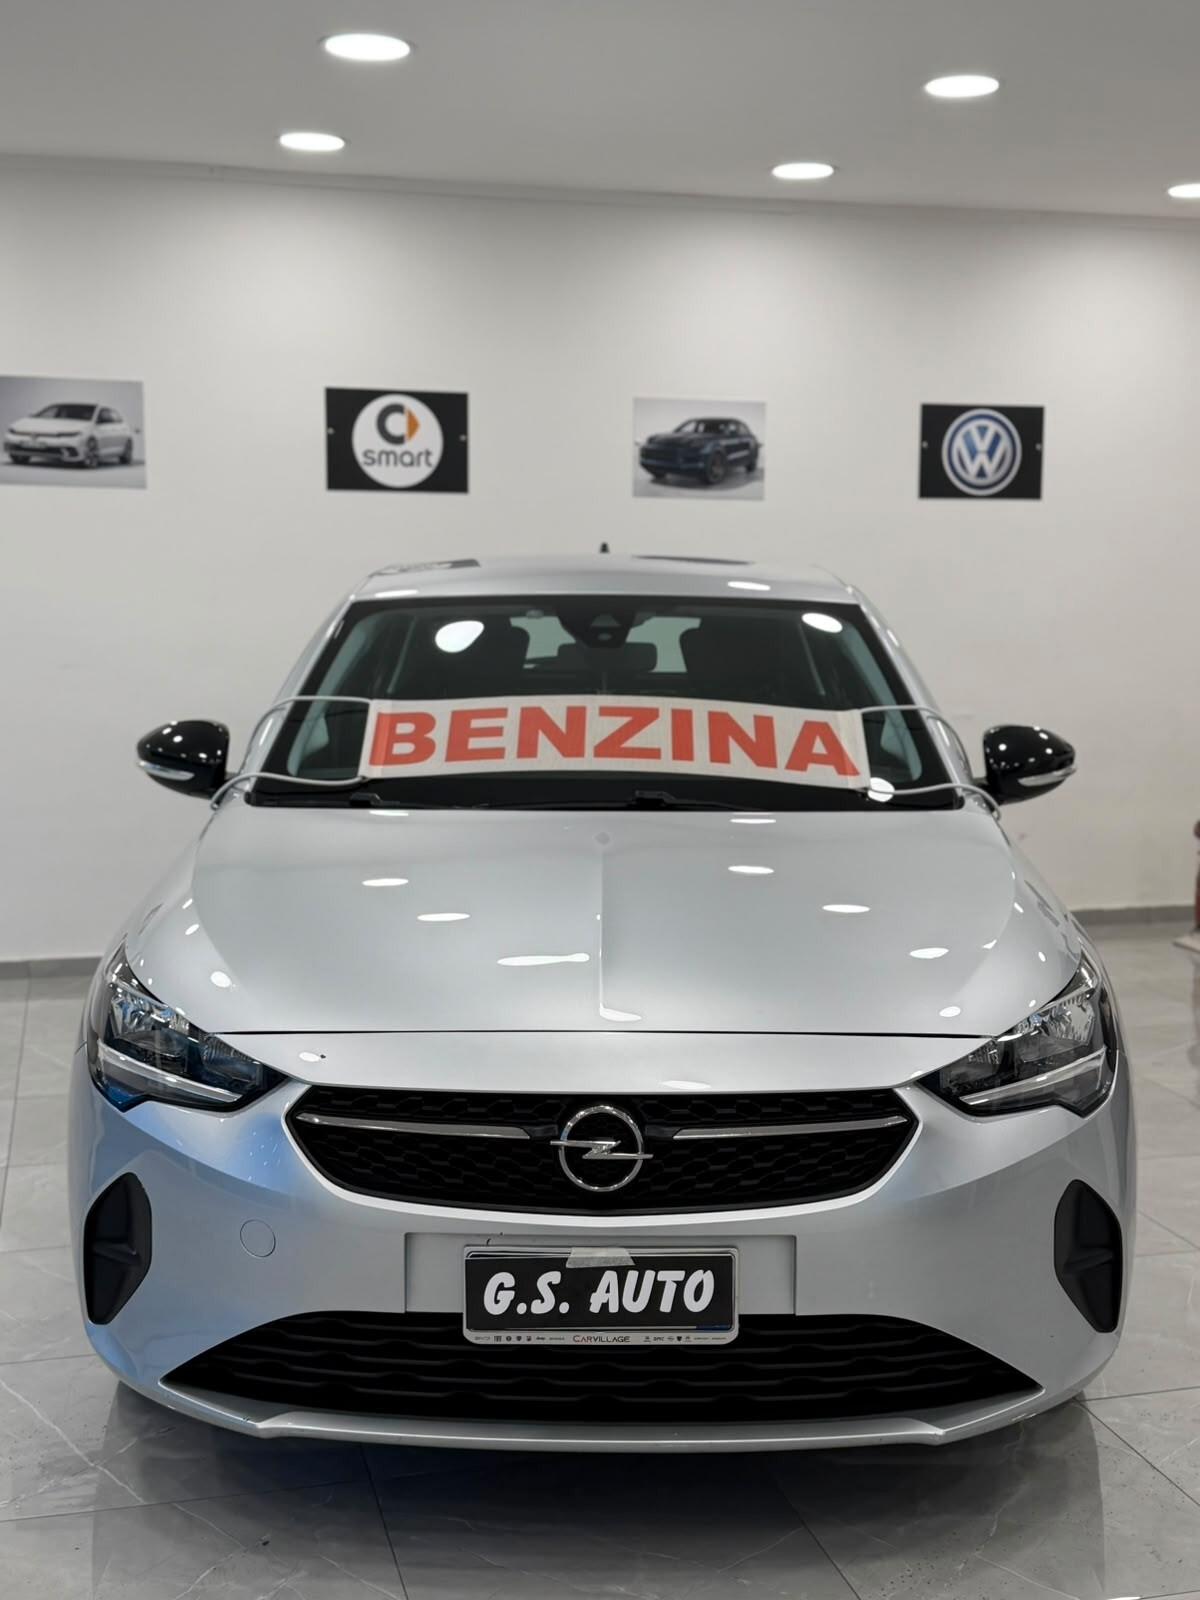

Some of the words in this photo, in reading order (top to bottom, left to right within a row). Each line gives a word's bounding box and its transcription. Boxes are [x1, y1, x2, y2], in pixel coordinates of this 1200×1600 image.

[362, 448, 434, 468] smart
[368, 705, 861, 776] BENZINA
[483, 1271, 570, 1316] G.S.
[588, 1269, 715, 1314] AUTO
